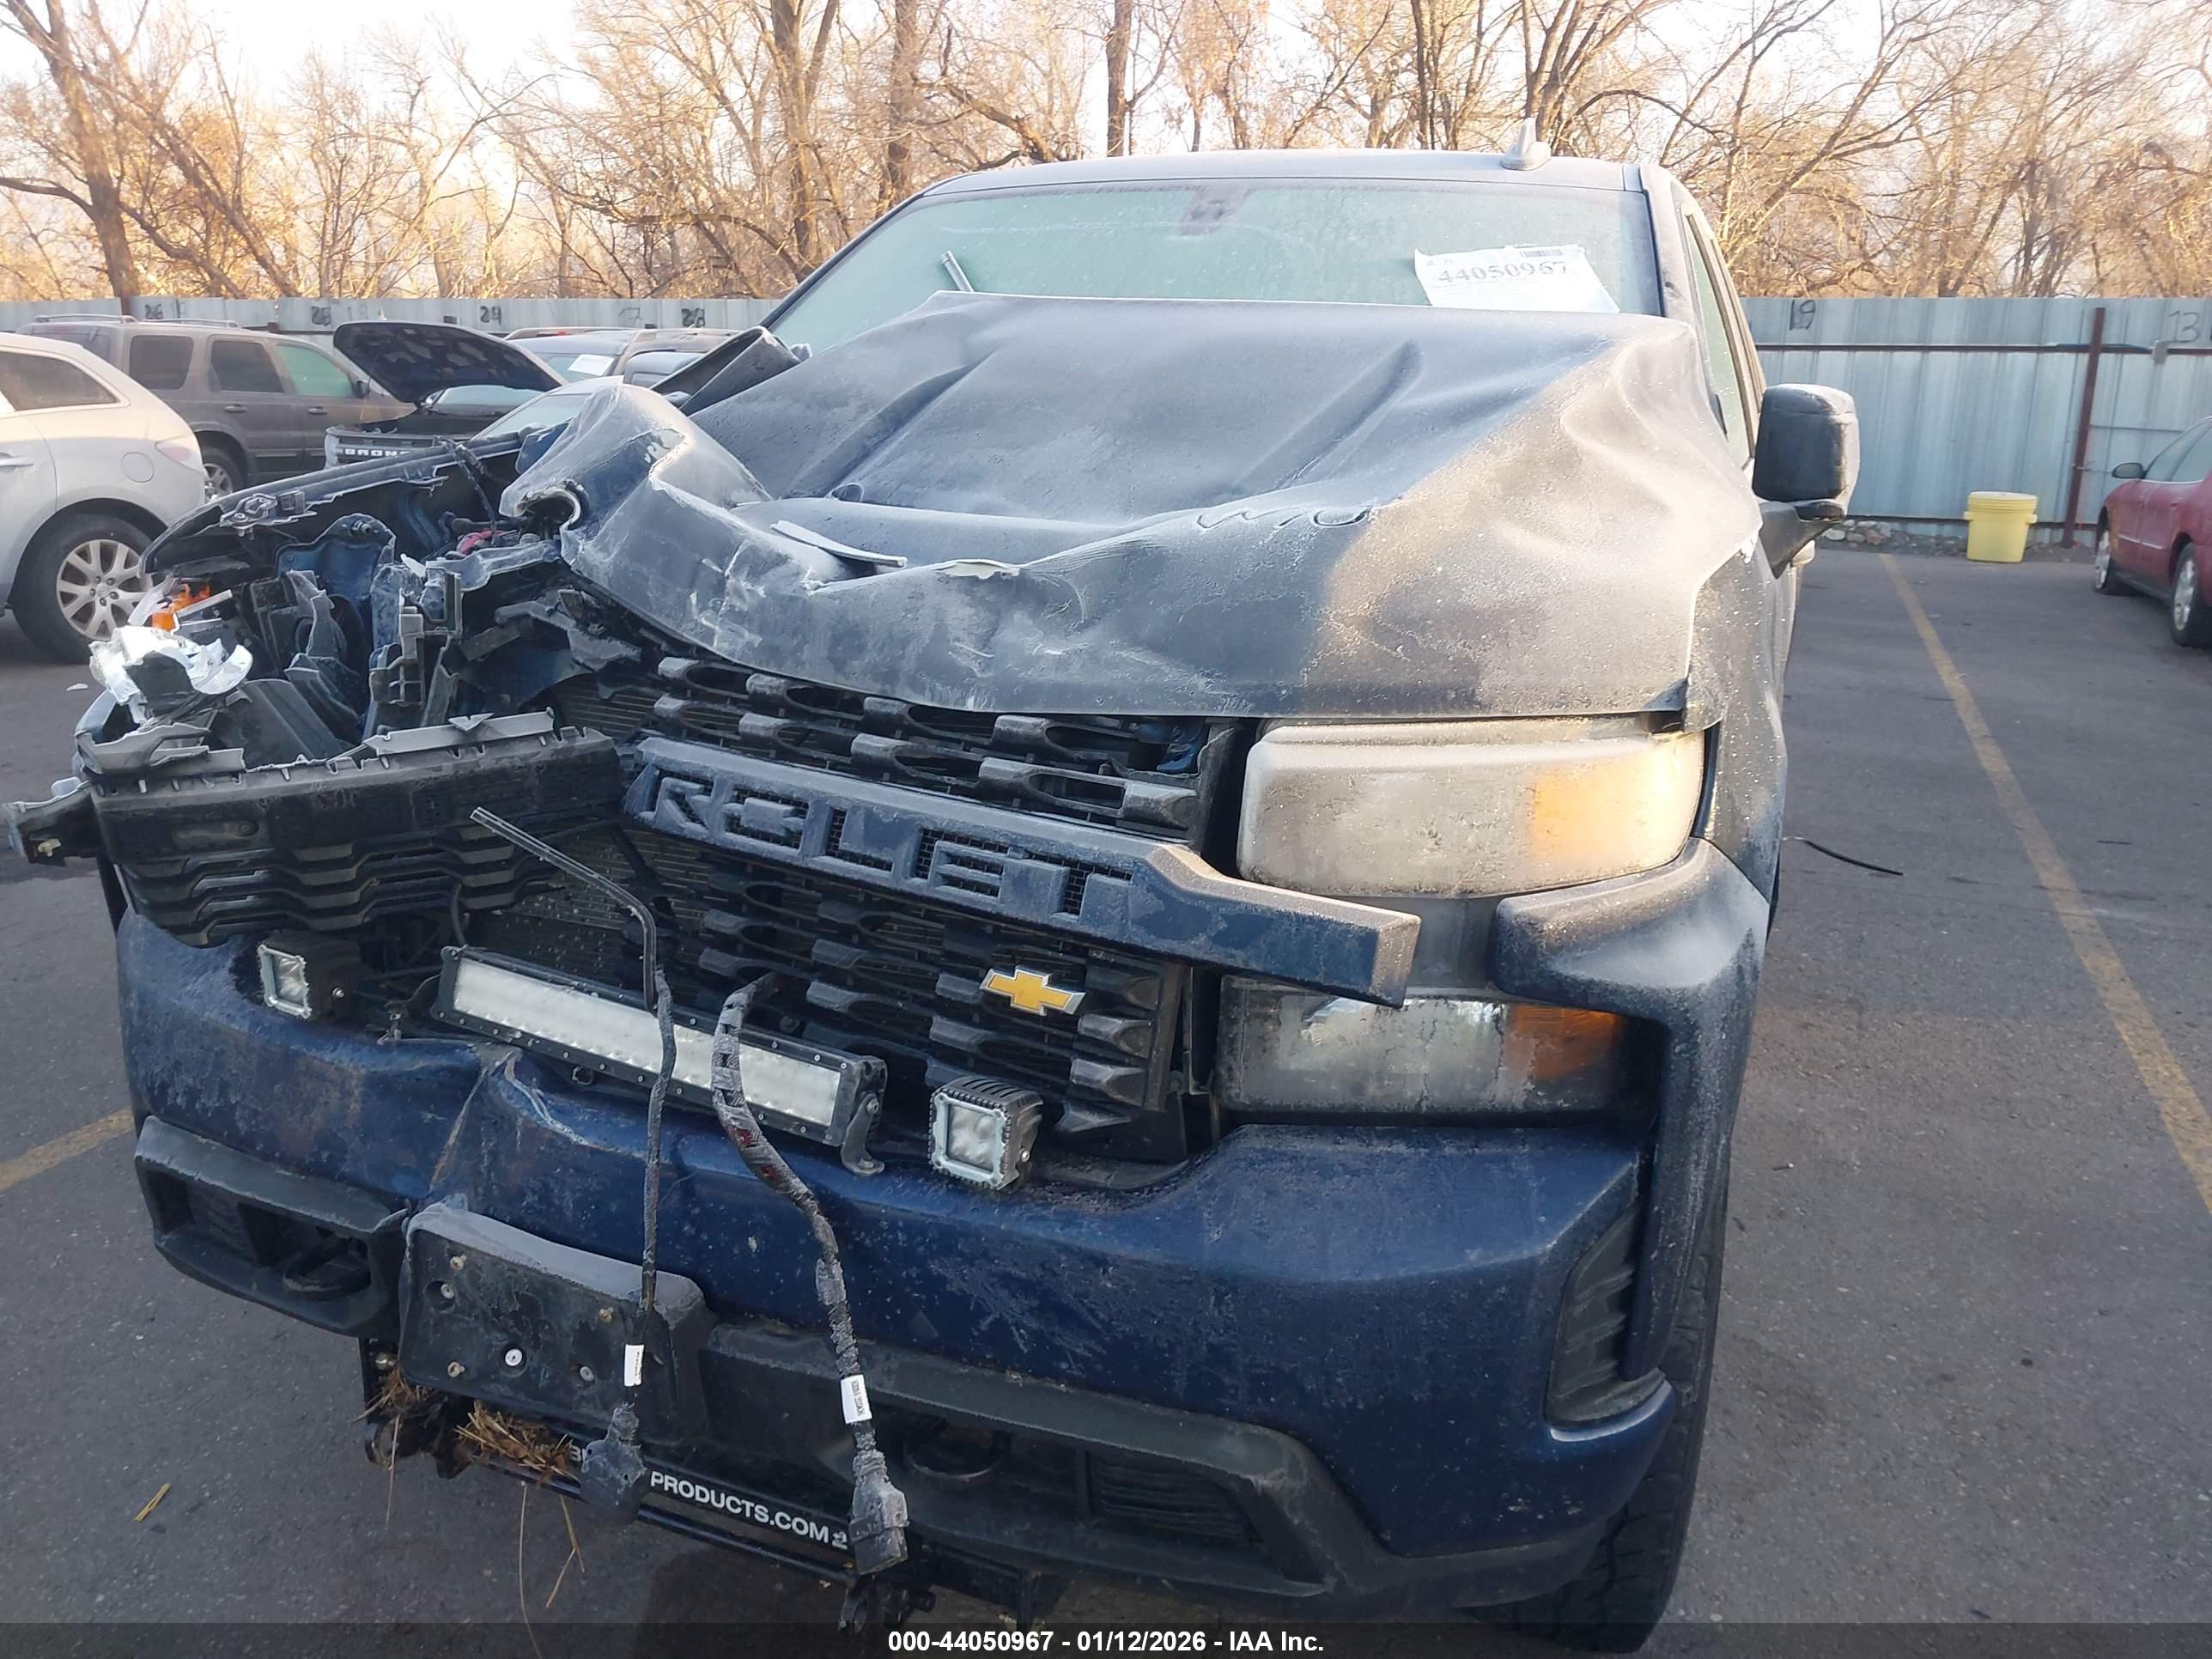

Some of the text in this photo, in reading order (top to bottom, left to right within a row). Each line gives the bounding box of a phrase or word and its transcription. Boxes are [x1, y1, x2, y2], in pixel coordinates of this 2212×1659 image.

[1437, 260, 1567, 283] 44050967
[480, 306, 502, 325] 24
[1790, 300, 1816, 331] 19
[2169, 310, 2199, 343] 13
[650, 1471, 830, 1543] PRODUCTS.COM
